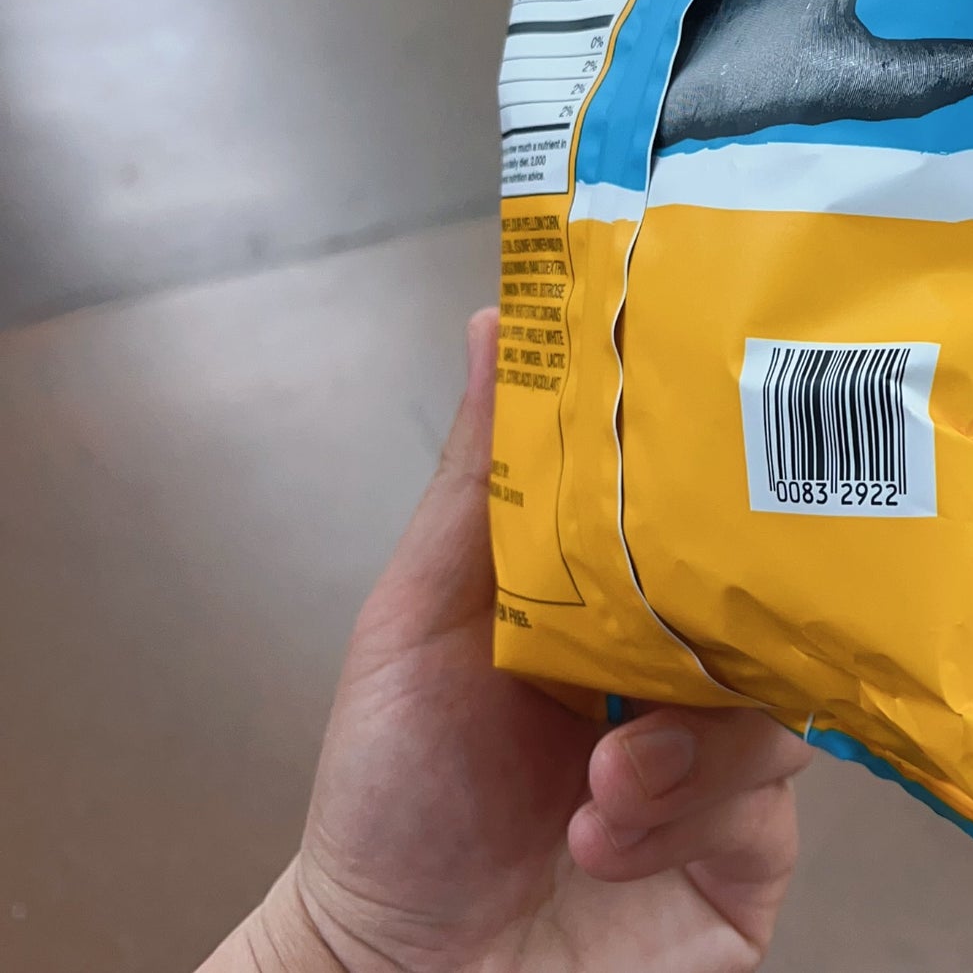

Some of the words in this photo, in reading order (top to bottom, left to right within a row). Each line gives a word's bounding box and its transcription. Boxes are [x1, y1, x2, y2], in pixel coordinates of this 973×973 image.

[590, 36, 605, 50] 0%
[582, 60, 598, 73] 2%
[570, 83, 587, 95] 2%
[558, 105, 574, 118] 2%
[776, 480, 828, 505] 0083
[840, 483, 898, 507] 2922
